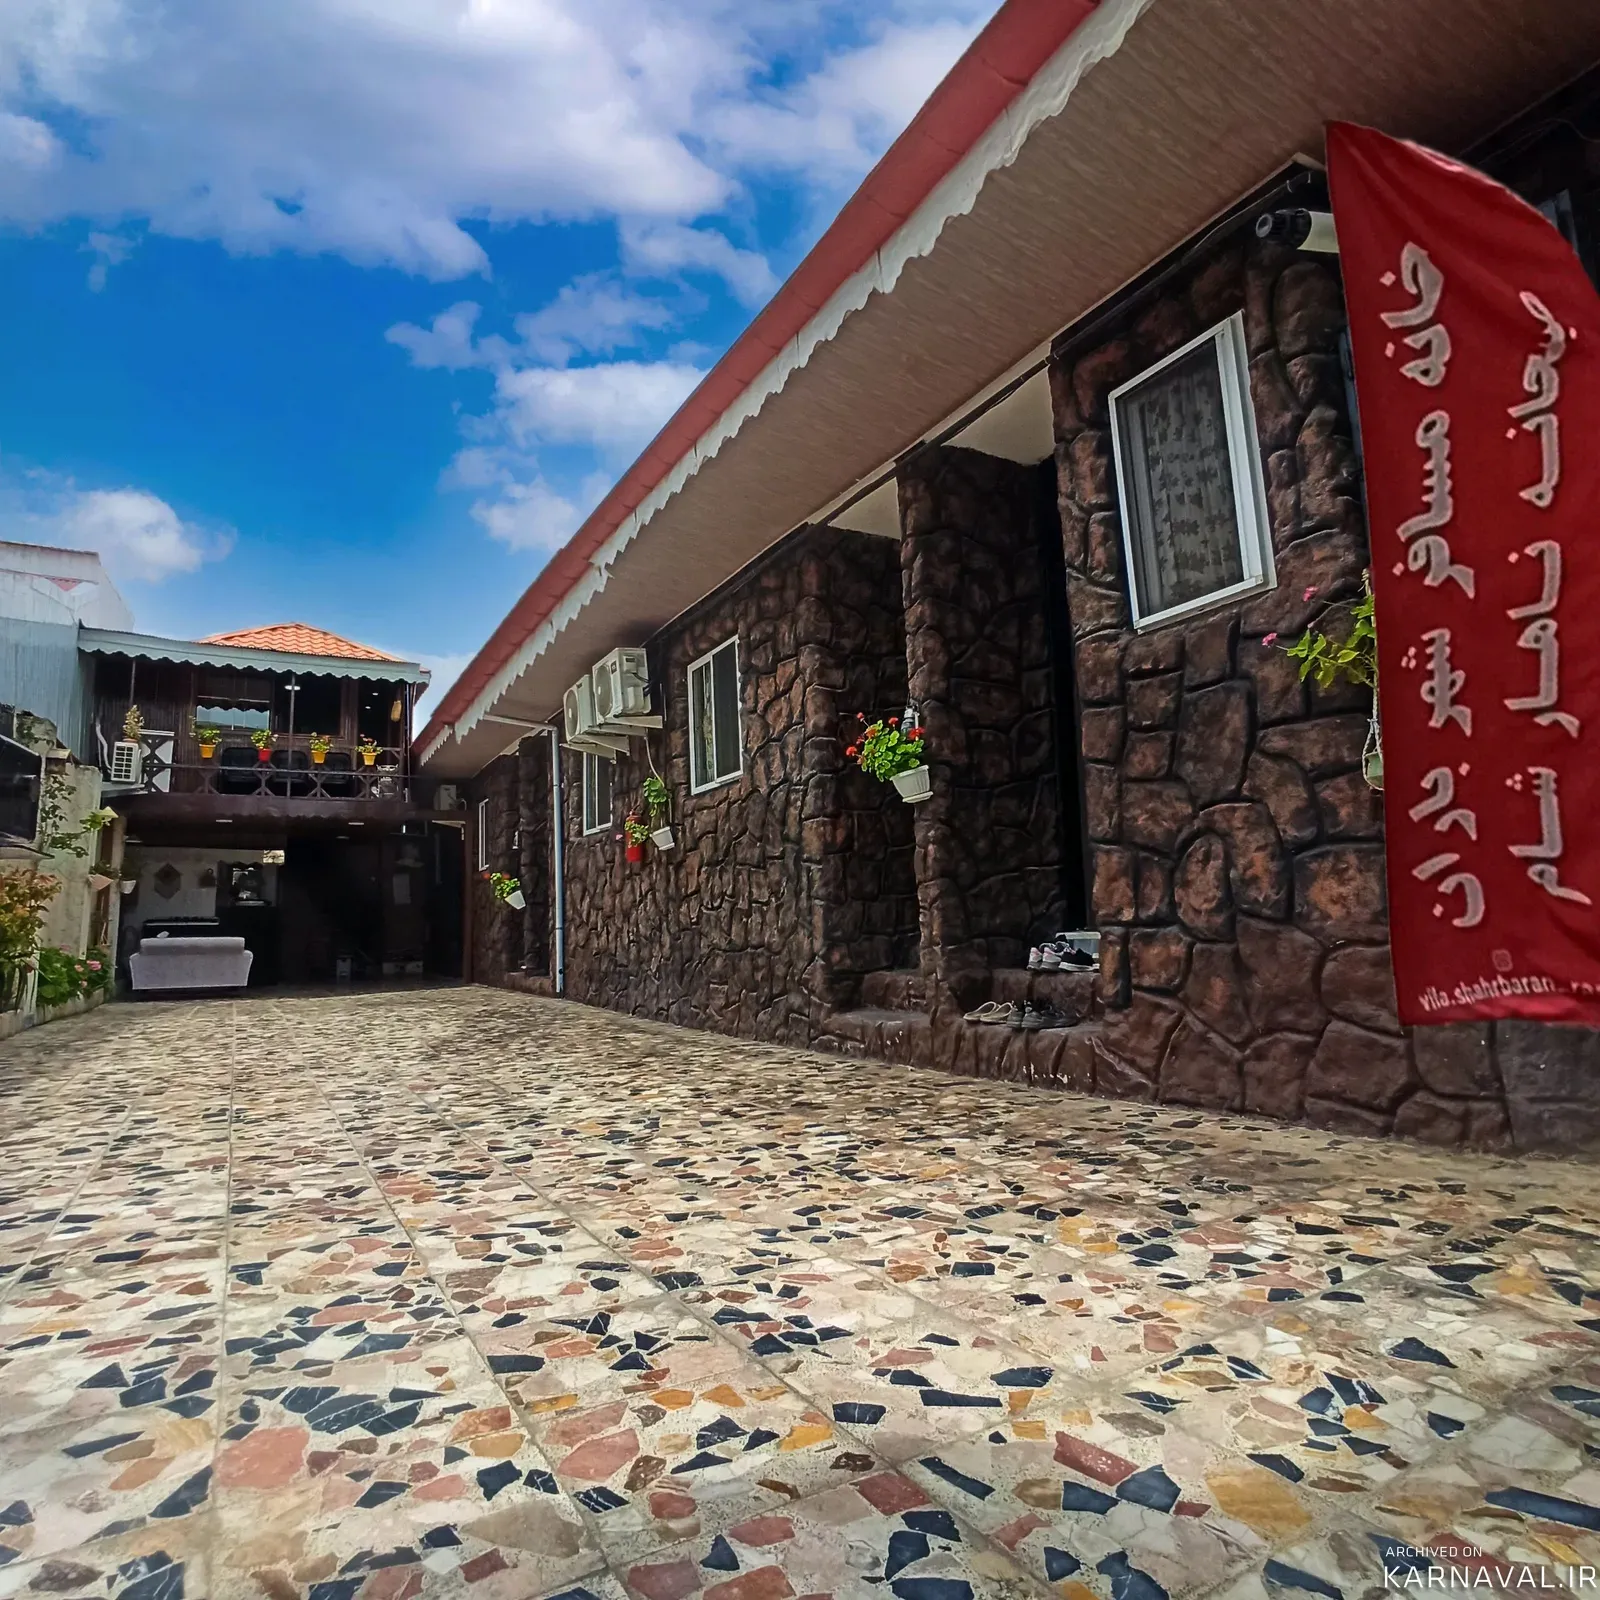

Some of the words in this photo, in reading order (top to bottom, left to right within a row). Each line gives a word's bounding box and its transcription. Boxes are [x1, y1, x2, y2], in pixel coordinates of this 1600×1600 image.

[1379, 241, 1452, 387] خانه
[1505, 291, 1578, 508] صبحانه
[1392, 409, 1475, 600] مسافر
[1400, 627, 1472, 737] شهر
[1503, 539, 1580, 738] ناهار
[1408, 762, 1486, 928] باران
[1505, 766, 1592, 905] شام
